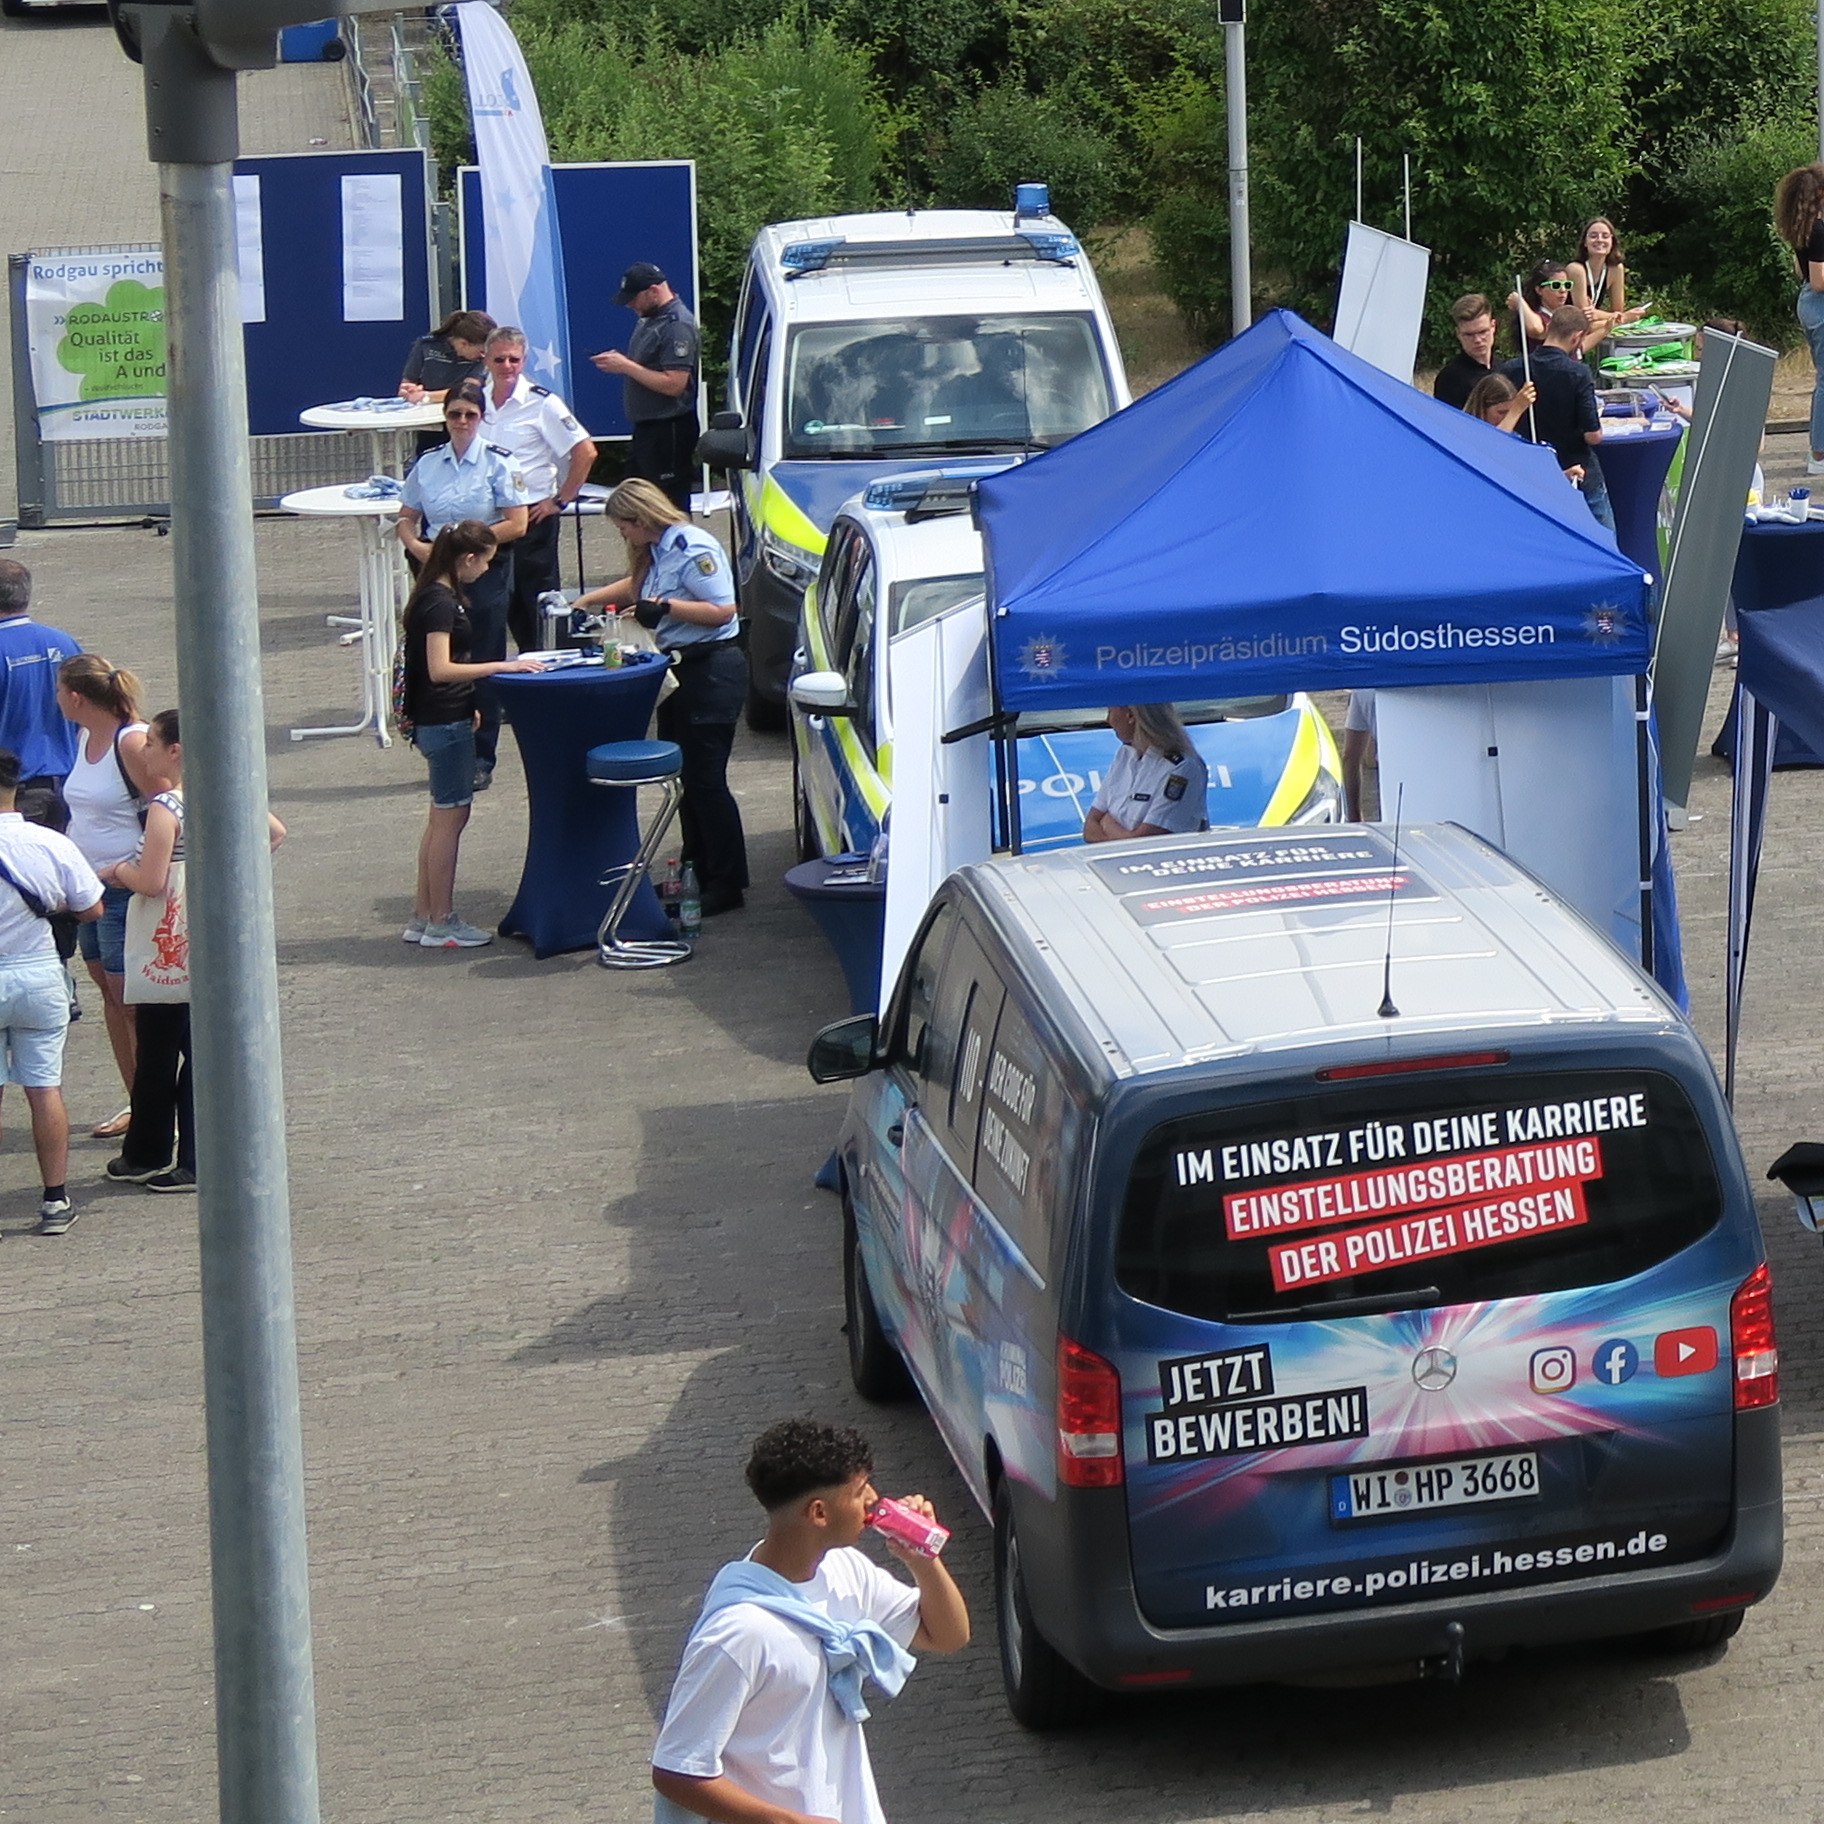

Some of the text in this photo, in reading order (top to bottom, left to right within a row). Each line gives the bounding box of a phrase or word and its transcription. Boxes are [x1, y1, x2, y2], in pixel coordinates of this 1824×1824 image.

[33, 259, 164, 281] Rodgau spricht
[70, 330, 140, 348] Qualität
[99, 348, 153, 363] ist das
[116, 365, 165, 378] A und
[73, 407, 168, 422] STADTWERK
[1096, 622, 1556, 670] Polizeipräsidium Südosthessen
[1119, 844, 1330, 876] IM EINSATZ FÜR
[1151, 849, 1375, 877] DEINE KARRIERE
[1147, 876, 1405, 911] EINSTELLUNGSBERATUNG
[1186, 882, 1395, 913] DER POLIZEI HESSEN
[1176, 1092, 1648, 1187] IM EINSATZ FÜR DEINE KARRIERE
[1231, 1140, 1597, 1234] EINSTELLUNGSBERATUNG
[1280, 1187, 1576, 1284] DER POLIZEI HESSEN
[1166, 1349, 1267, 1406] JETZT
[1153, 1393, 1363, 1459] BEWERBEN!
[1353, 1459, 1537, 1511] WI HP 3668
[1205, 1529, 1670, 1610] karriere.polizei.hessen.de
